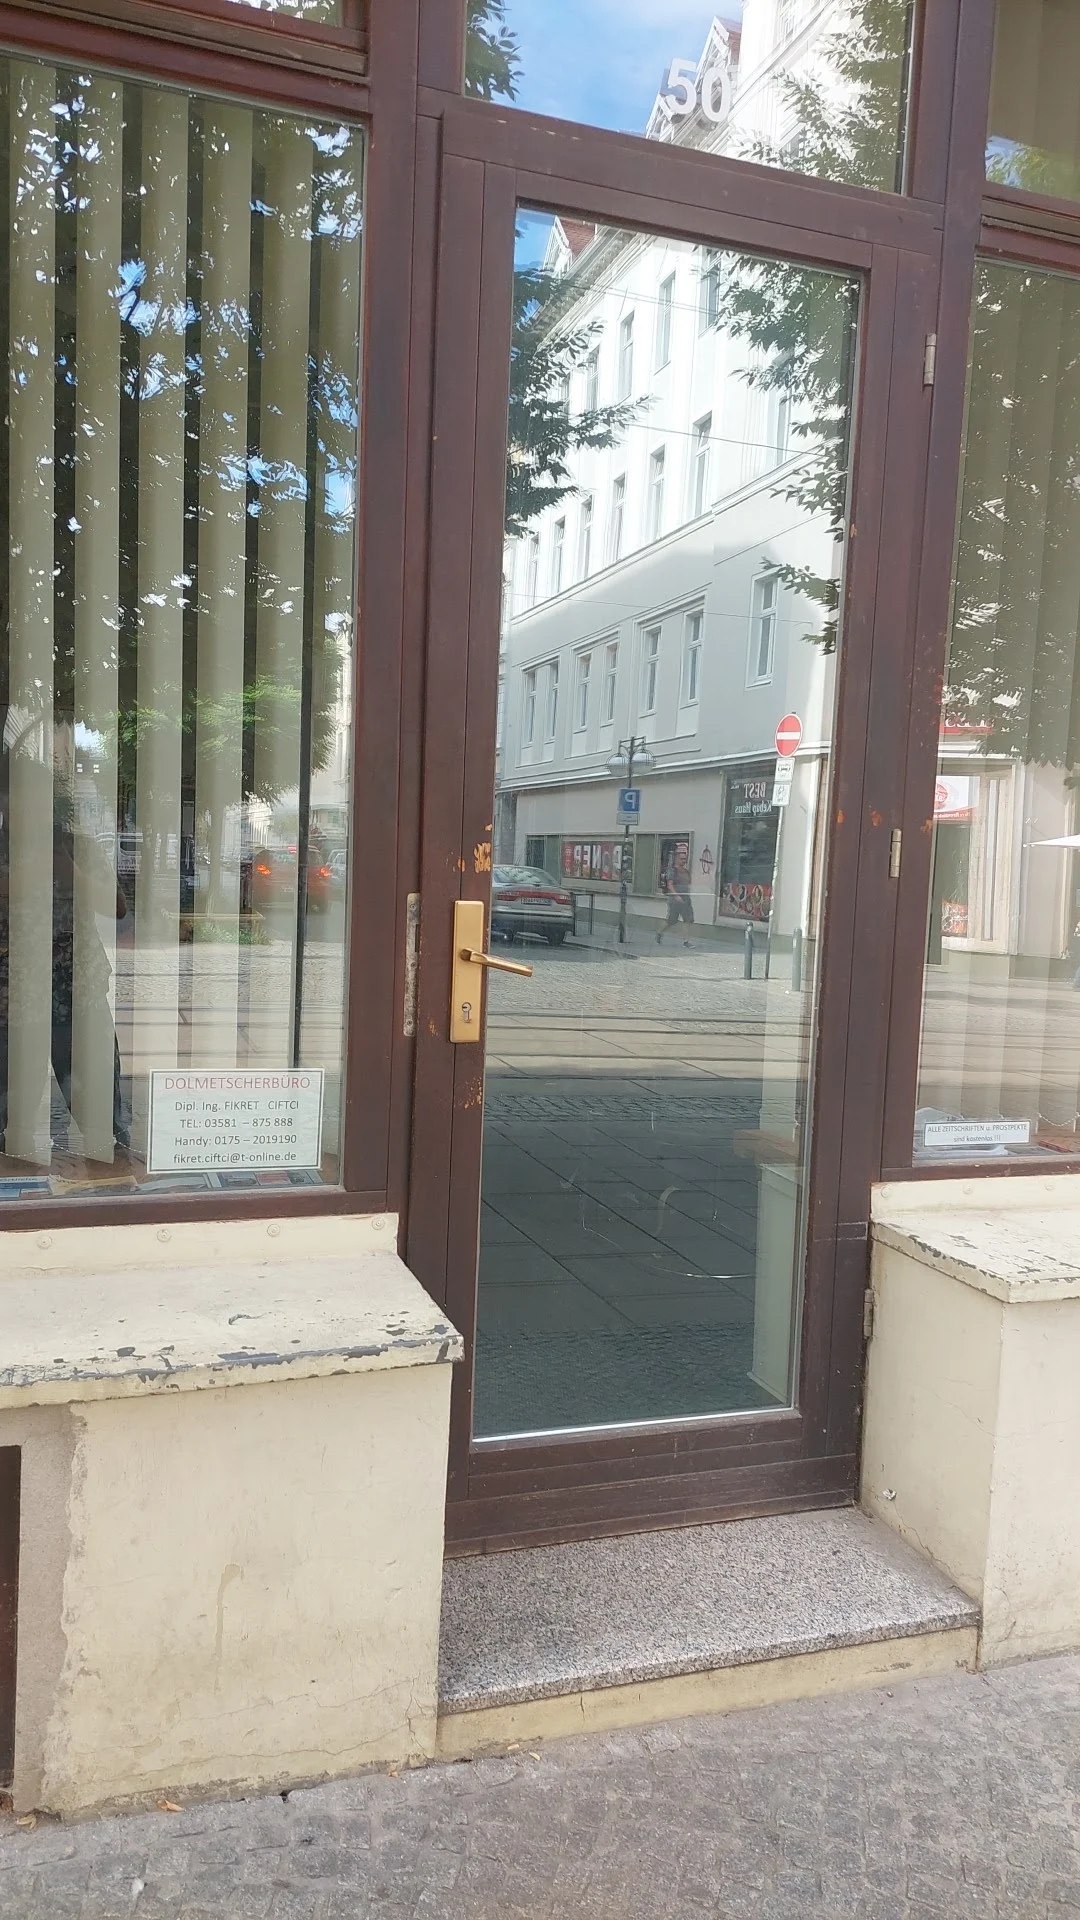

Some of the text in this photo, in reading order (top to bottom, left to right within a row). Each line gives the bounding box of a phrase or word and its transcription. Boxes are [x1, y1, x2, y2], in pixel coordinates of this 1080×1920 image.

[664, 58, 732, 122] 50
[165, 1075, 311, 1090] DOLMETSCHERBÜRO
[175, 1100, 299, 1113] Dipl. Ing. FIKRET CIFTCI
[180, 1119, 201, 1128] TEL:
[204, 1118, 237, 1128] 03581
[252, 1117, 271, 1127] 875
[274, 1117, 293, 1127] 888
[927, 1125, 942, 1133] ALLE
[942, 1124, 985, 1132] ZEITSCHRIFTEN
[174, 1136, 211, 1147] Handy:
[214, 1135, 240, 1145] 0175
[253, 1134, 297, 1145] 2019190
[966, 1134, 993, 1142] kostenlos
[173, 1151, 297, 1164] fikret.ciftci@t-online.de
